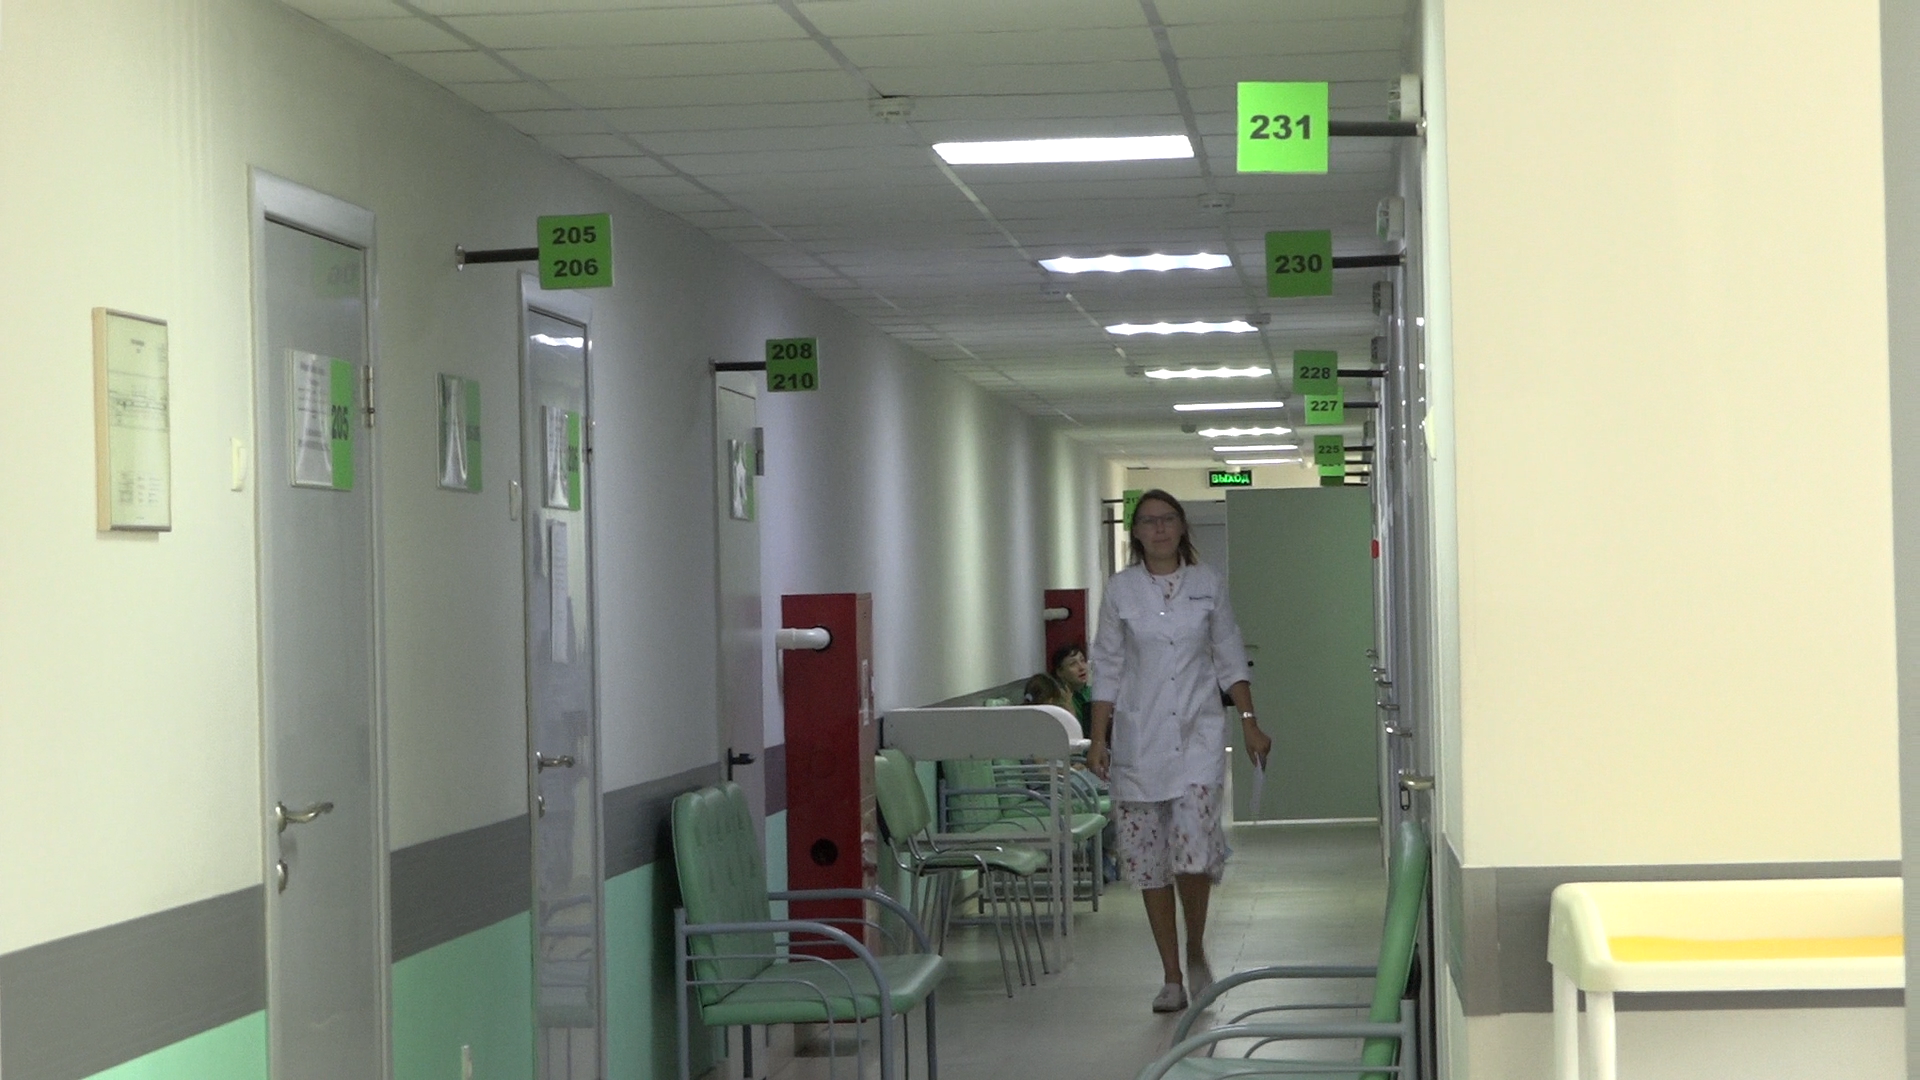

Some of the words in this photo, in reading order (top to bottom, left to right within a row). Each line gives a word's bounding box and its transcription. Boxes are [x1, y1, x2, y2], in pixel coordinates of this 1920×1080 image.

[1250, 114, 1311, 140] 231
[552, 226, 597, 245] 205
[553, 258, 599, 277] 206
[1275, 254, 1323, 274] 230
[771, 343, 812, 360] 208
[773, 372, 814, 389] 210
[1300, 366, 1331, 380] 228
[1310, 400, 1338, 412] 227
[331, 404, 349, 441] 205
[1318, 445, 1340, 455] 225
[1211, 474, 1251, 484] ВЫХОД
